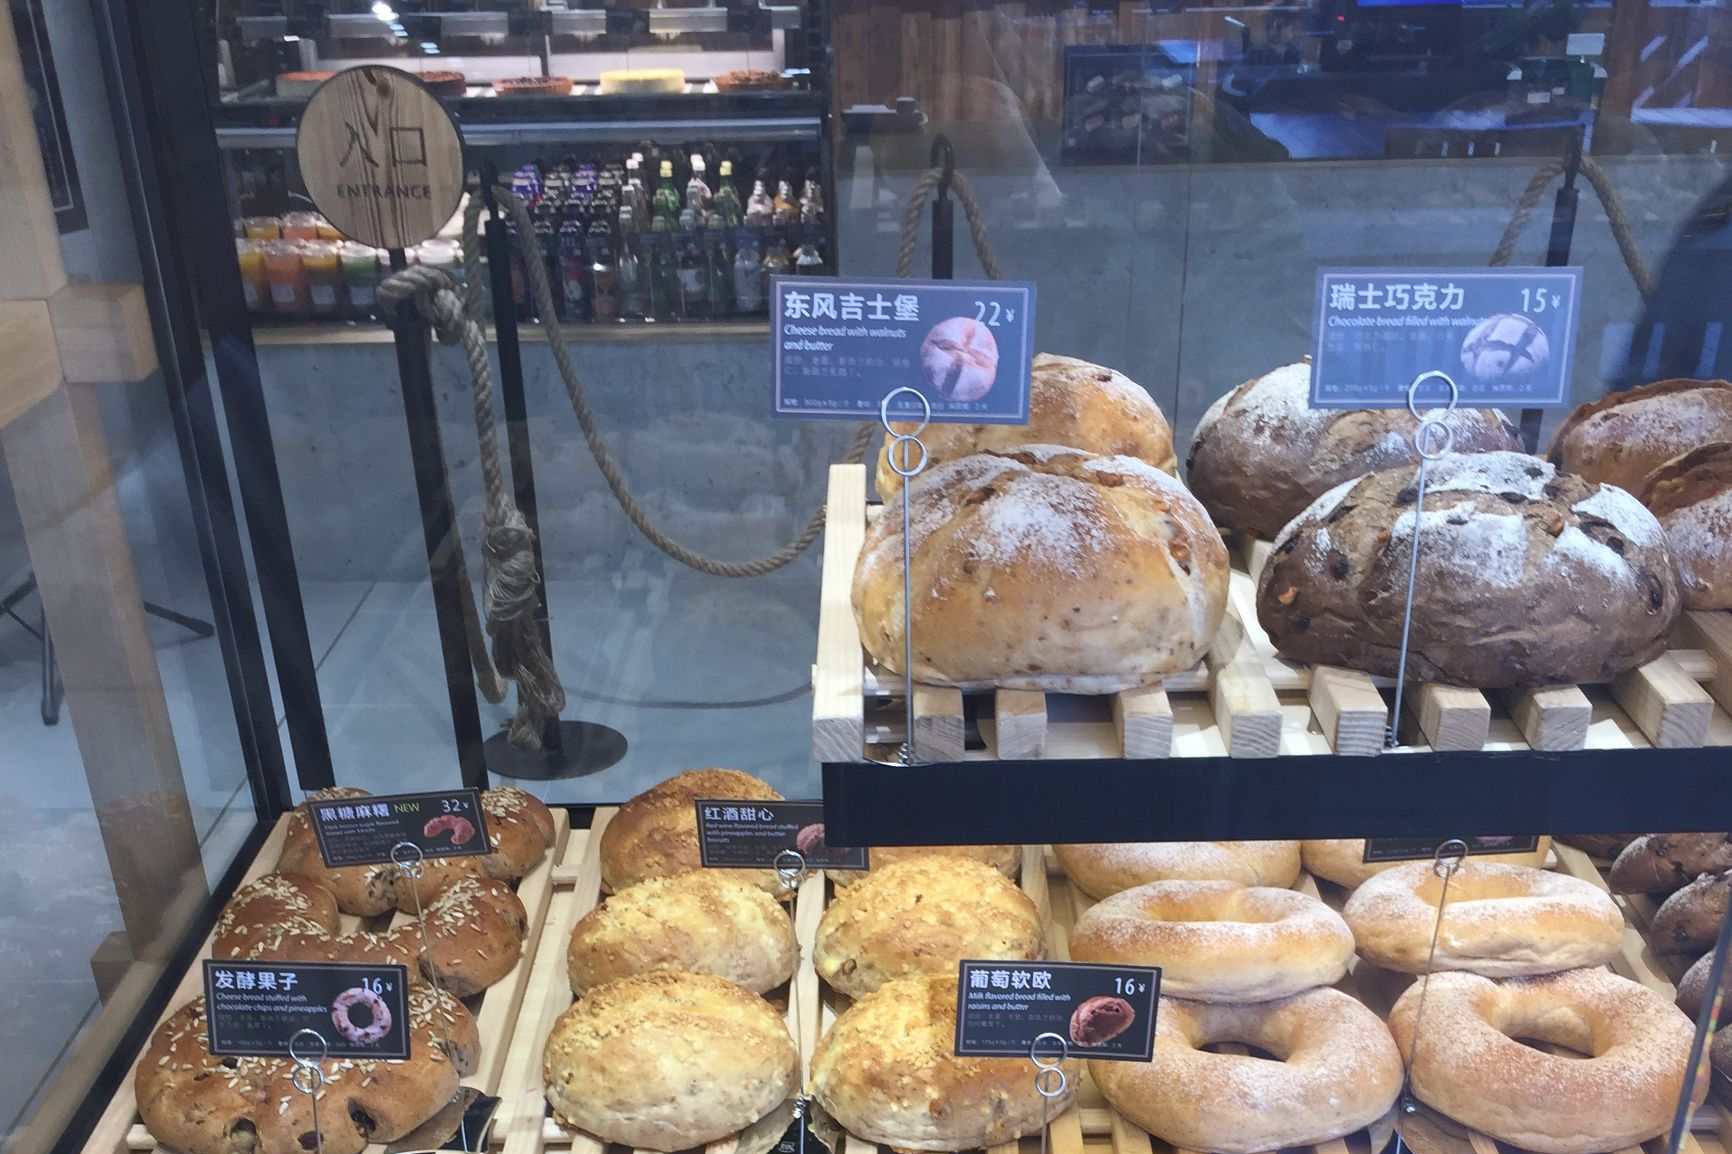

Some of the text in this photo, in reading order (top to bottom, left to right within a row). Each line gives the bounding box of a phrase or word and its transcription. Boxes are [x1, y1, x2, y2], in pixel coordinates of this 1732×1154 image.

[339, 122, 428, 169] 入口
[336, 184, 432, 199] ENTRANCE
[1329, 283, 1465, 311] 瑞士巧克力
[783, 291, 920, 322] 东风吉士堡
[1328, 315, 1376, 327] Chocolate
[1376, 315, 1405, 327] bread
[1405, 315, 1429, 327] filled
[1429, 315, 1450, 327] with
[783, 323, 908, 338] Cheese bread with walnuts
[783, 339, 834, 351] and butter
[393, 802, 420, 814] NEW
[704, 806, 775, 821] 红酒甜心
[215, 970, 298, 991] 发酵果子
[970, 970, 1052, 990] 葡萄软欧
[968, 992, 984, 1000] Milk
[984, 992, 1014, 1001] flavored
[1015, 992, 1035, 1001] bread
[1055, 993, 1072, 1002] with
[273, 1004, 288, 1012] and
[1007, 1003, 1030, 1011] butter
